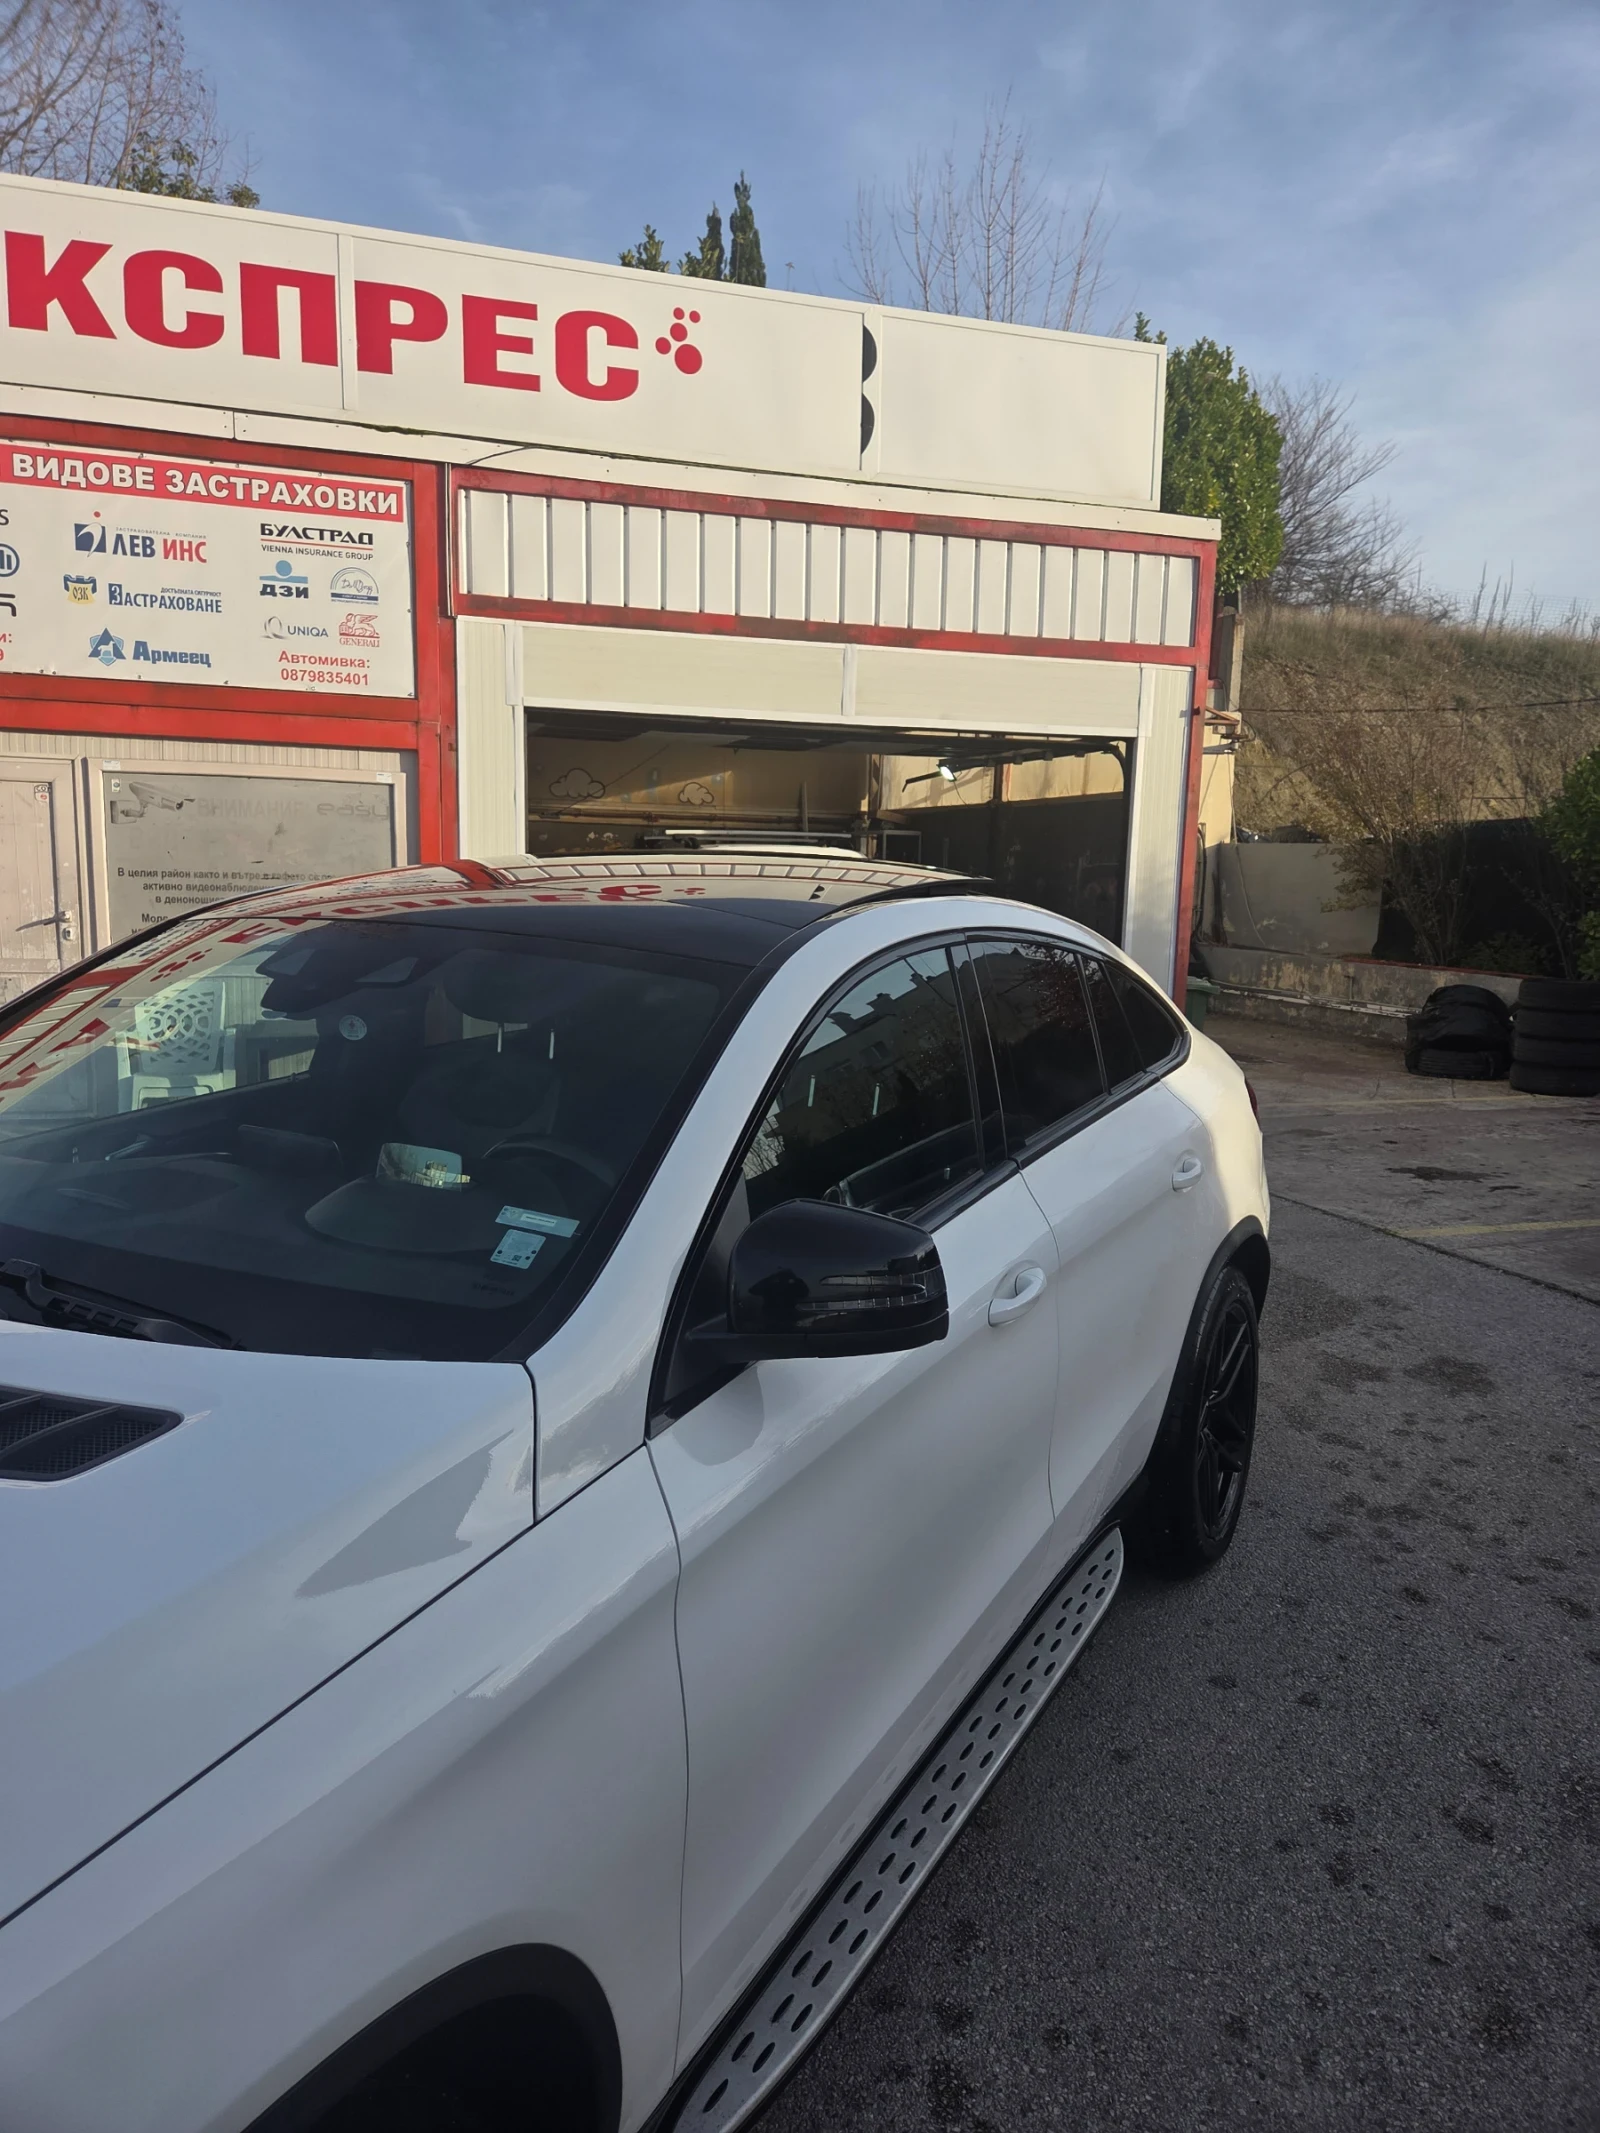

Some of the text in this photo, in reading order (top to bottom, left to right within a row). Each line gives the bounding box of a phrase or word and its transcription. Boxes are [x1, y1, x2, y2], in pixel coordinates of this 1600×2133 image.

[4, 229, 640, 402] КСПРЕС
[12, 452, 399, 516] ВИДОВЕ ЗАСТРАХОВКИ
[260, 523, 373, 546] БУЛСТРАД
[112, 533, 208, 564] ЛЕВ ИНС
[261, 544, 374, 561] VIENNA INSURANCE GROUP
[259, 583, 309, 599] ДЗИ
[287, 625, 329, 638] UNIQA
[339, 637, 380, 648] GENERALI
[133, 640, 212, 668] Армеец
[278, 650, 371, 669] Автомивка:
[280, 668, 370, 686] 0879835401
[117, 867, 125, 877] В
[127, 869, 159, 880] целия
[161, 868, 191, 883] район
[193, 870, 220, 880] както
[222, 871, 229, 880] и
[142, 881, 183, 892] активно
[155, 895, 162, 904] в
